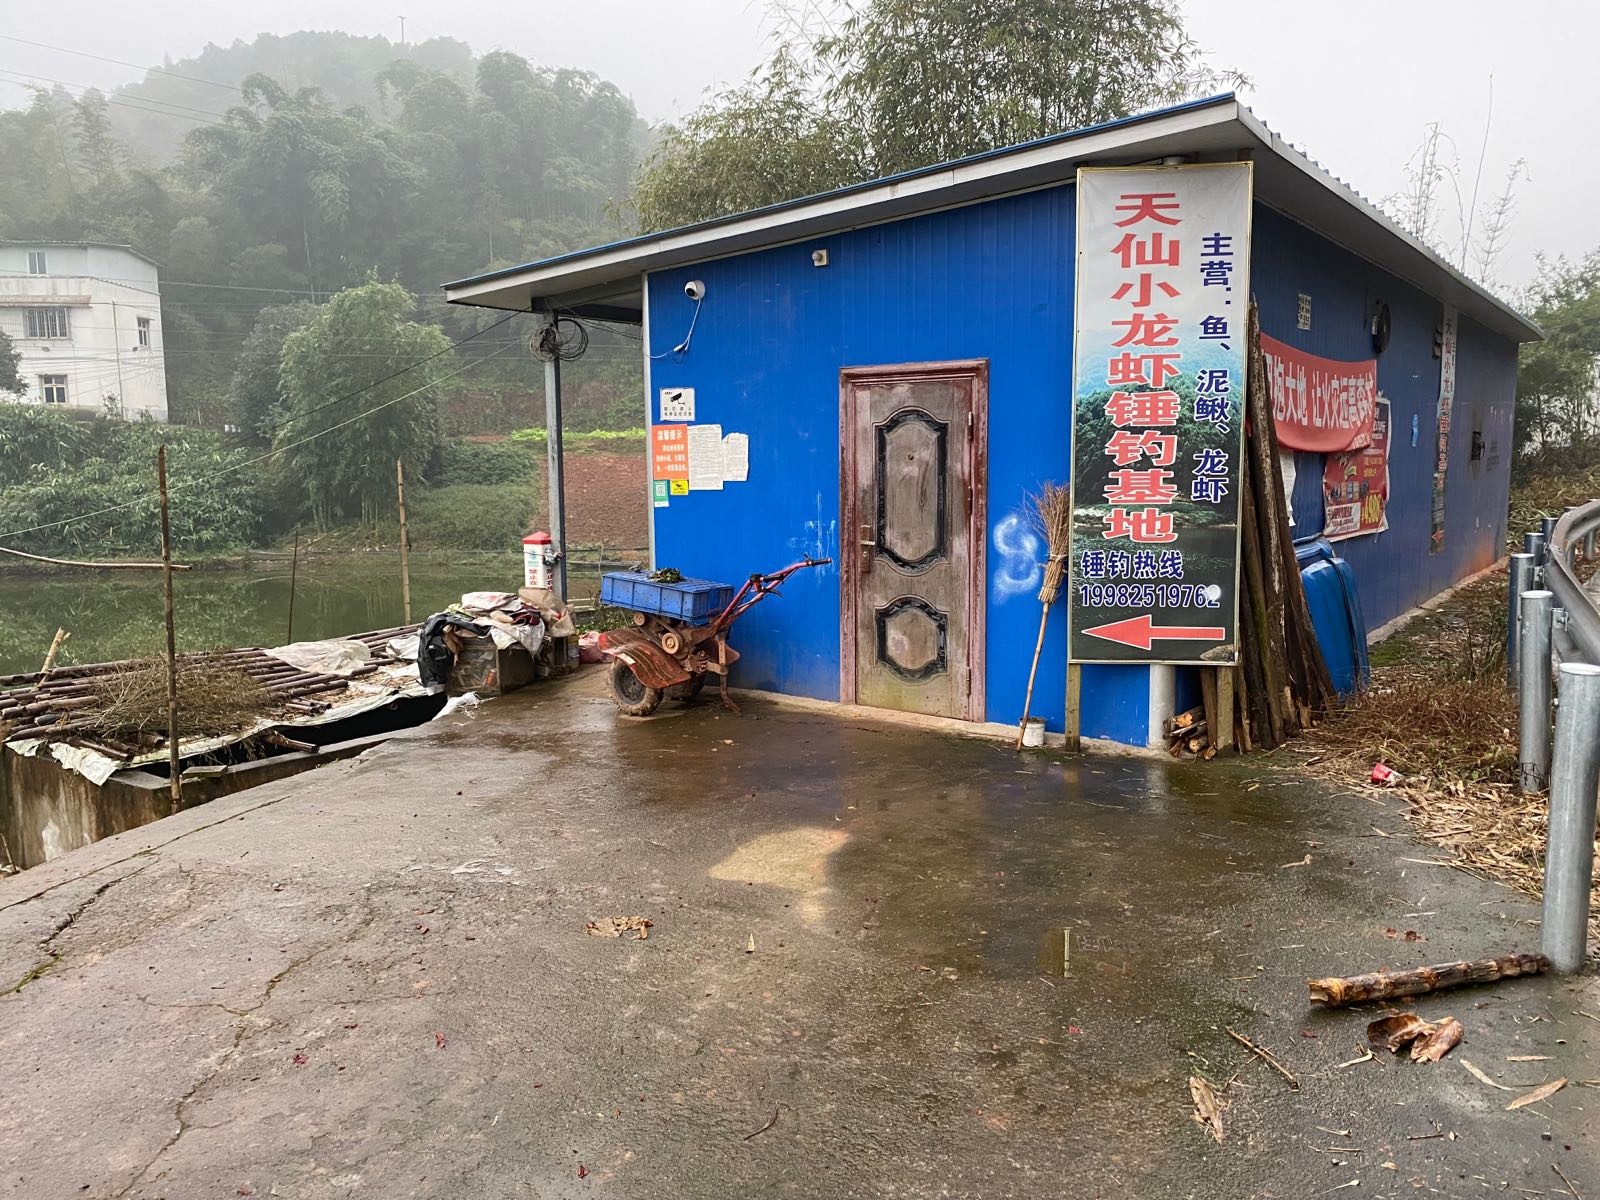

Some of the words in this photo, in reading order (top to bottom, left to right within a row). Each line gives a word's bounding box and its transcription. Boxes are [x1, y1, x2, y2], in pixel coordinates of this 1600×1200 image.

[1103, 193, 1183, 543] 天仙小龙虾锤钓基地
[1081, 550, 1184, 579] 锤钓热线
